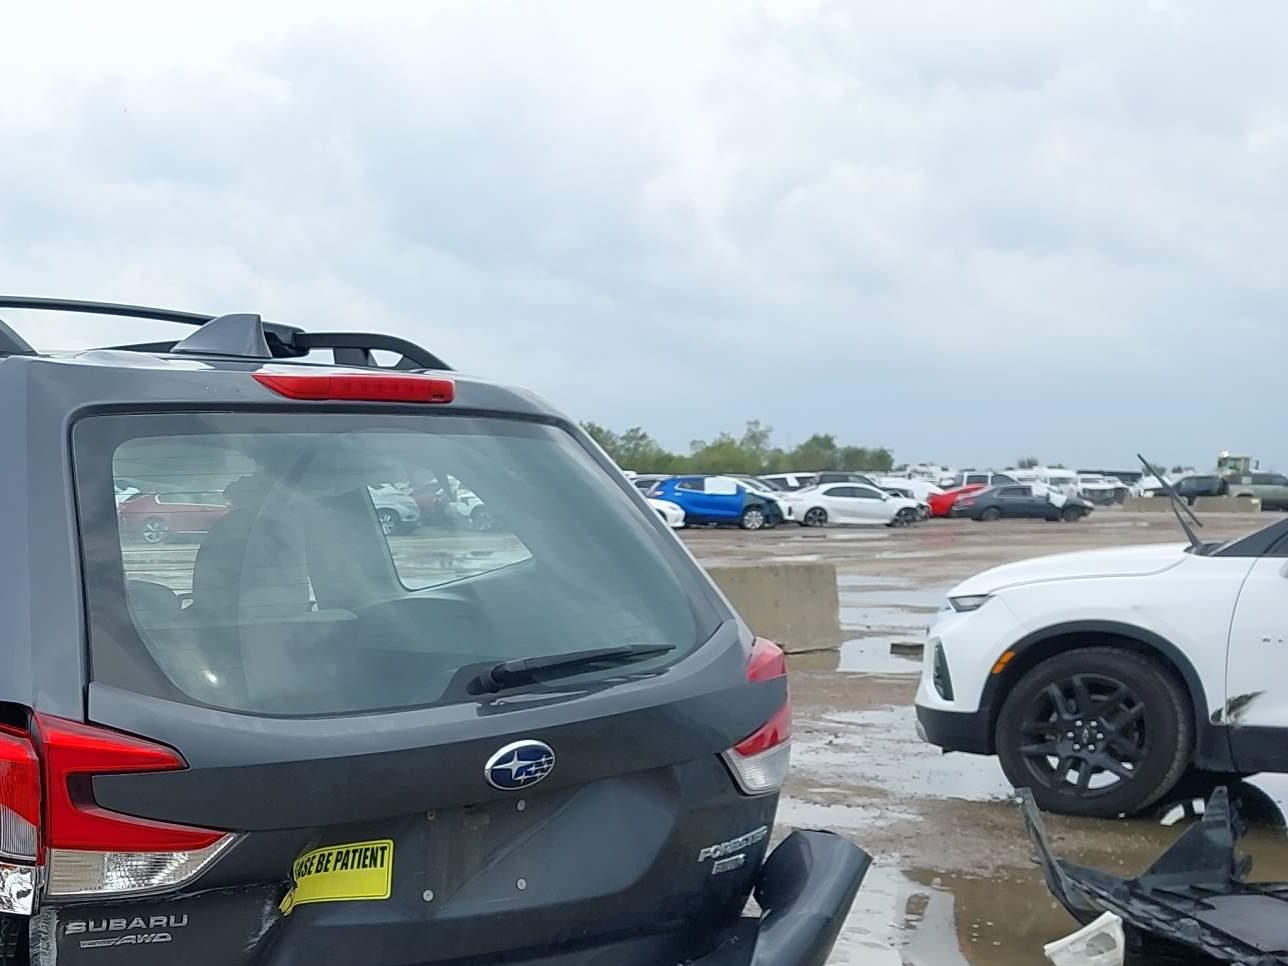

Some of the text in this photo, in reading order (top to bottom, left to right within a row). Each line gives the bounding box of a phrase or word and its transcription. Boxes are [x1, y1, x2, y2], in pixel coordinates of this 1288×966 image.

[315, 852, 333, 874] BE
[333, 846, 387, 871] PATIENT
[65, 915, 188, 935] SUBARU
[114, 933, 172, 945] AWD
